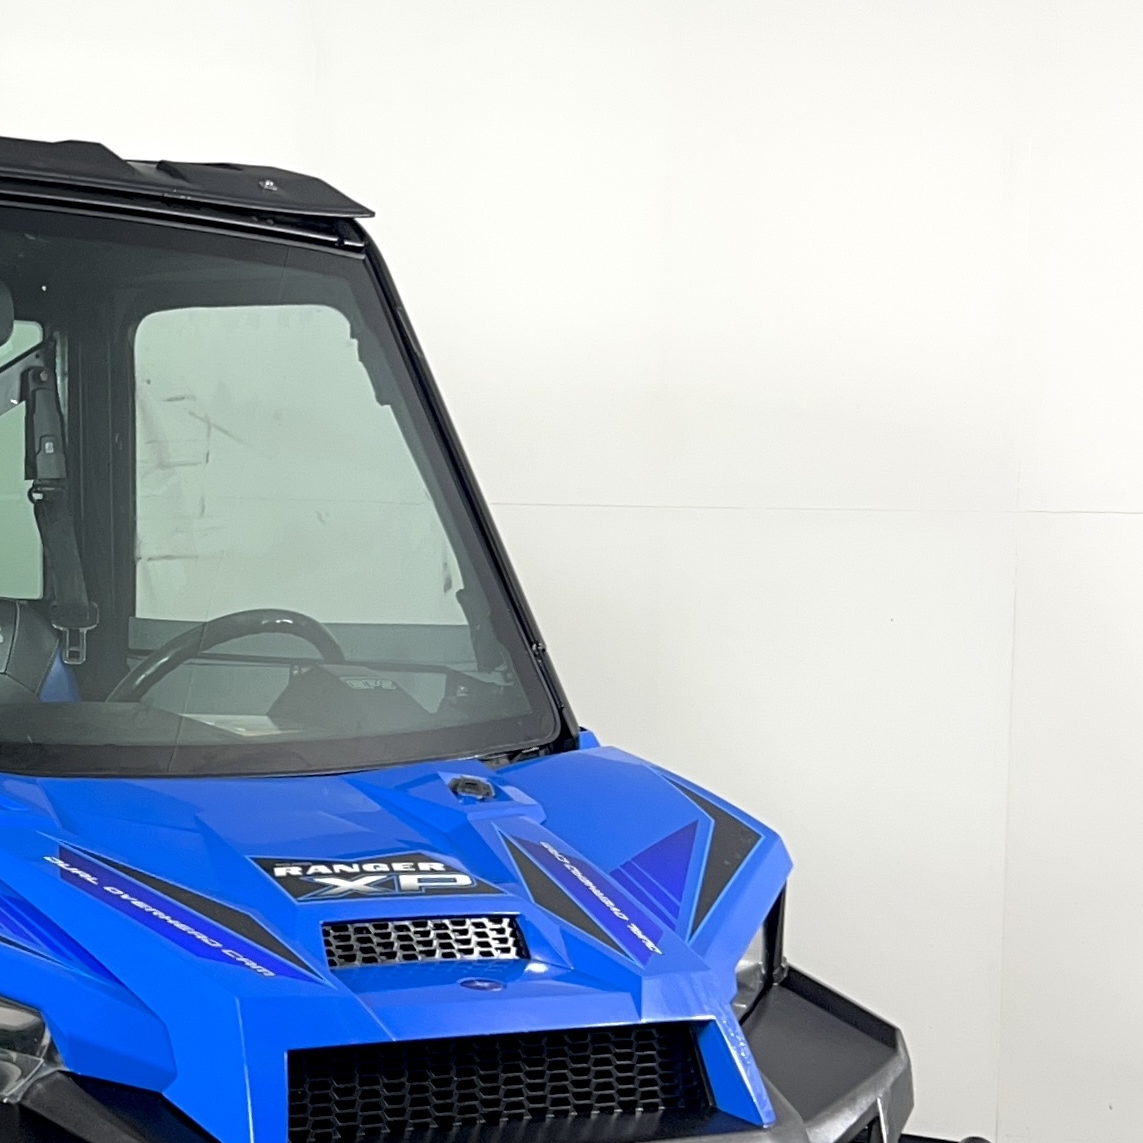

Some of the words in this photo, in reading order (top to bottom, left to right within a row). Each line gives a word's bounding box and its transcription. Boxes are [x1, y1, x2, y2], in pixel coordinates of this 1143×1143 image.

[273, 861, 446, 878] RANGER
[309, 873, 474, 896] XP
[43, 855, 99, 886] DUAL
[103, 885, 223, 949] OVERHEAD
[221, 949, 277, 977] CAM
